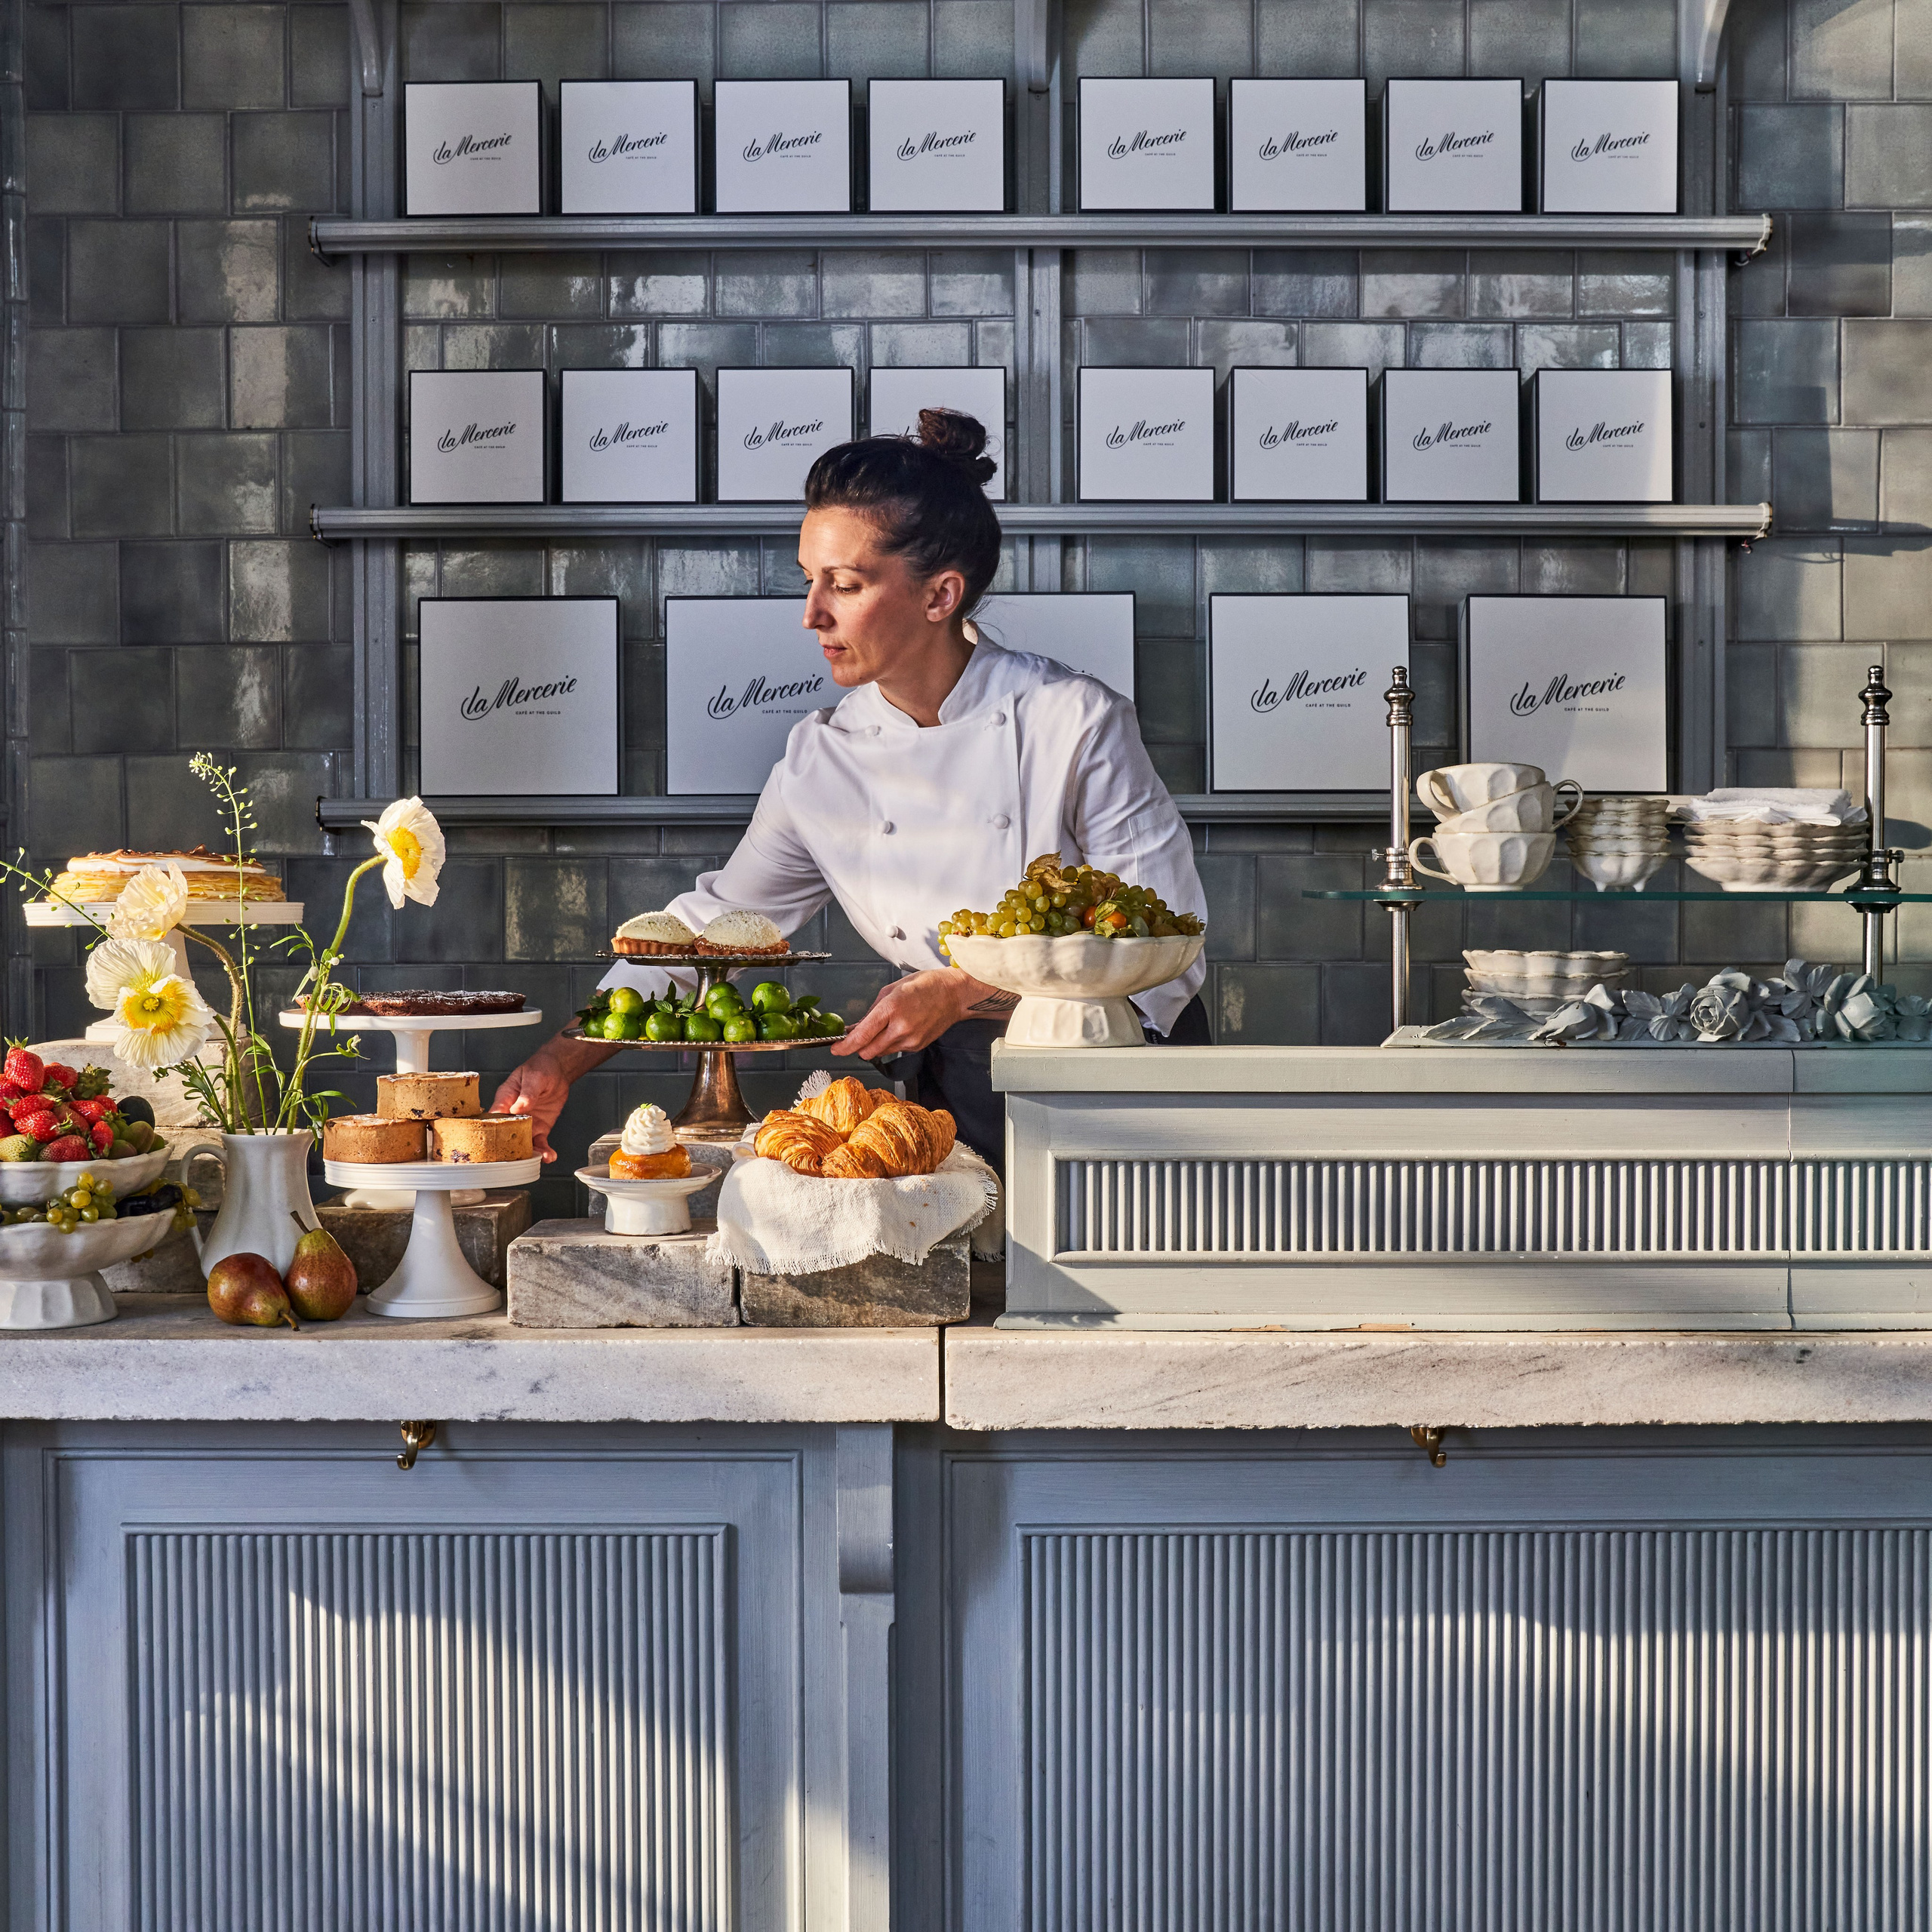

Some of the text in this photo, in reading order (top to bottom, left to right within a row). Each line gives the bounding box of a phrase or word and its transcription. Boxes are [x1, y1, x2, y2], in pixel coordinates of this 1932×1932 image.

[451, 133, 512, 156] Mercerie
[607, 131, 668, 155] Mercerie
[761, 130, 823, 153] Mercerie
[915, 130, 977, 152] Mercerie
[1126, 128, 1187, 151] Mercerie
[1278, 129, 1338, 152] Mercerie
[1434, 130, 1494, 152] Mercerie
[1589, 131, 1650, 153] Mercerie
[456, 421, 517, 445] Mercerie
[608, 420, 669, 443] Mercerie
[763, 418, 824, 441] Mercerie
[1124, 418, 1186, 441] Mercerie
[1278, 418, 1339, 441] Mercerie
[1431, 420, 1492, 442] Mercerie
[1584, 420, 1644, 442] Mercerie
[488, 675, 577, 709] Mercerie
[735, 674, 824, 707] Mercerie
[1278, 668, 1367, 700] Mercerie
[1537, 672, 1626, 704] Mercerie
